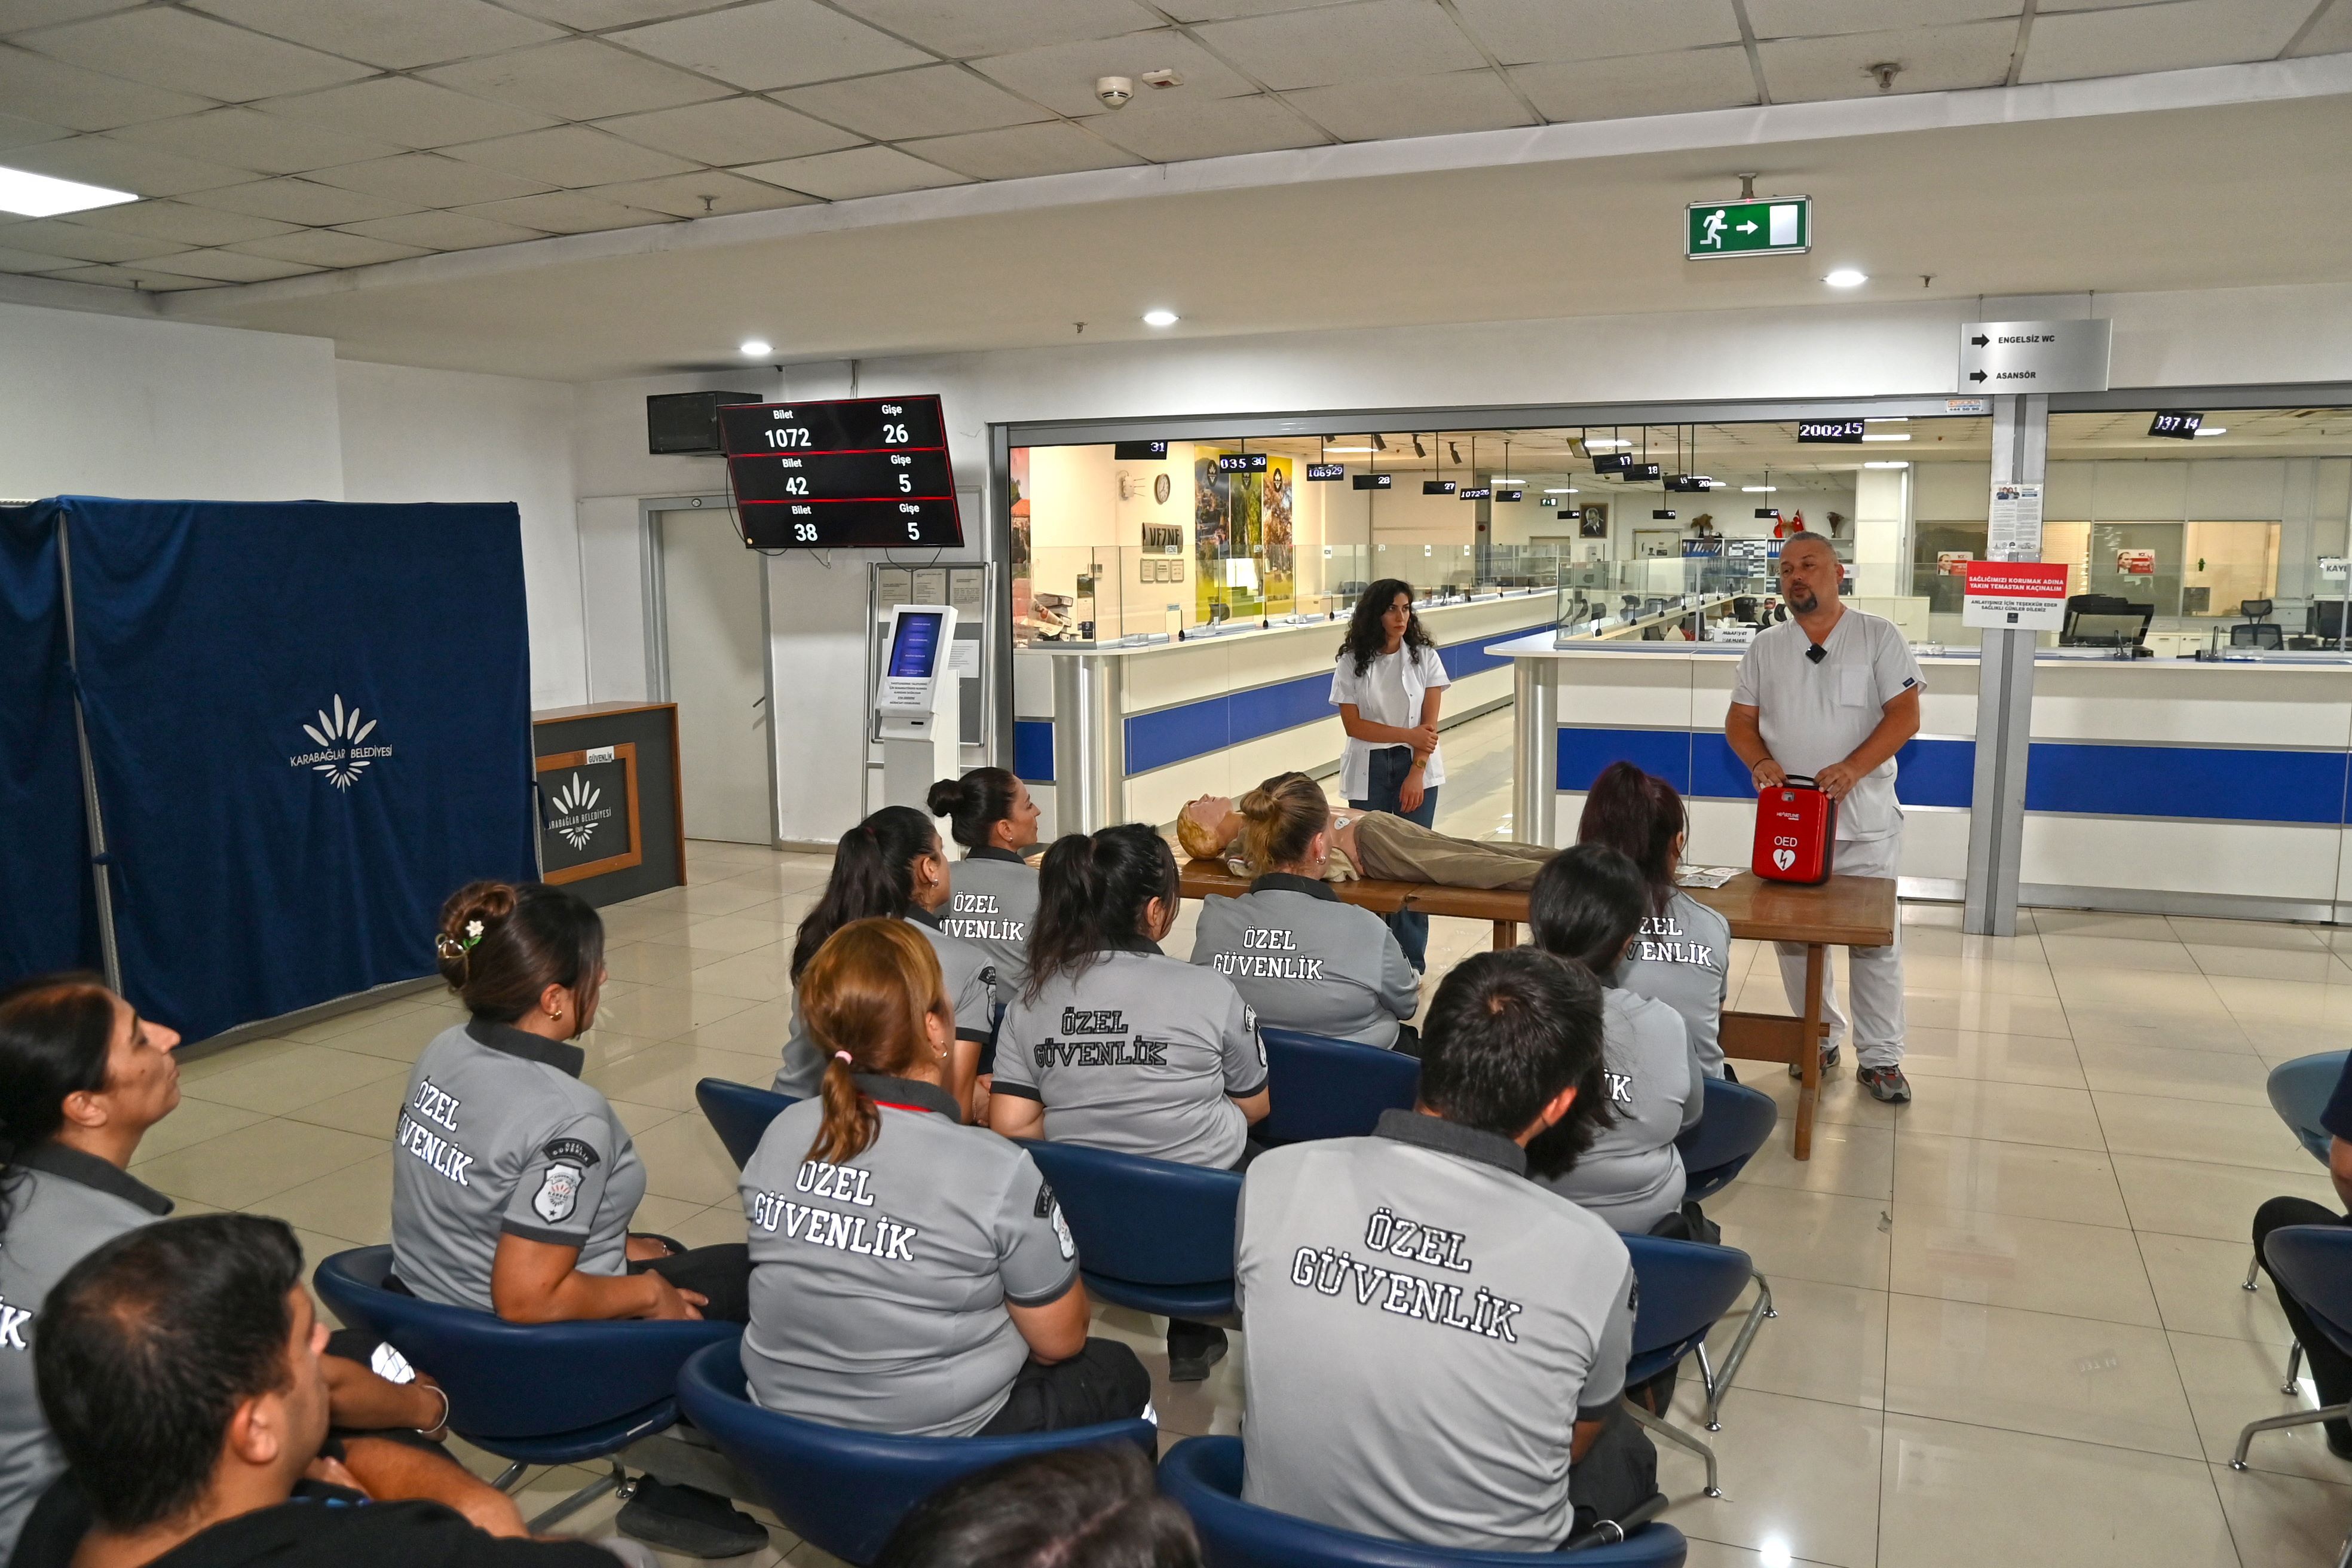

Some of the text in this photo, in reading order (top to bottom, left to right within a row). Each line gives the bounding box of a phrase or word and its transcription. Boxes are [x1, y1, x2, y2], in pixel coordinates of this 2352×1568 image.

[1998, 334, 2039, 344] ENGELSİZ
[1996, 370, 2036, 379] ASANSÖR
[773, 409, 794, 419] Bilet
[882, 404, 902, 416] Gişe
[1800, 422, 1863, 436] 2002 15
[2183, 417, 2199, 430] 14
[765, 428, 812, 448] 1072
[883, 424, 909, 443] 26
[1150, 442, 1165, 452] 31
[782, 458, 803, 468] Bilet
[890, 455, 911, 467] Gişe
[1220, 457, 1266, 468] 035 30
[1620, 456, 1631, 466] 17
[1648, 466, 1658, 474] 18
[1309, 466, 1343, 477] 1069 29
[785, 477, 809, 495] 42
[899, 474, 911, 493] 5
[792, 505, 812, 515] Bilet
[899, 503, 920, 515] Gişe
[794, 523, 818, 541] 38
[907, 522, 920, 540] 5
[290, 744, 393, 767] KARABAĞLAR BELEDİYESİ
[589, 752, 612, 763] GÜVENLİK
[545, 807, 611, 830] ARABAĞLAR BELEDİYESİ
[1774, 836, 1797, 847] OED
[953, 890, 999, 914] ÖZEL
[939, 915, 1025, 941] ÜVENLİK
[1639, 916, 1683, 936] ZEL
[1243, 926, 1297, 951] ÖZEL
[1627, 940, 1712, 967] VENLİK
[1213, 951, 1324, 980] GÜVENLİK
[1061, 1007, 1128, 1035] ÖZEL
[1033, 1035, 1168, 1067] GÜVENLİK
[414, 1076, 461, 1132] ÖZEL
[754, 1190, 918, 1261] GÜVENLİK
[1365, 1206, 1471, 1273] ÖZEL
[1291, 1246, 1522, 1343] GÜVENLİK
